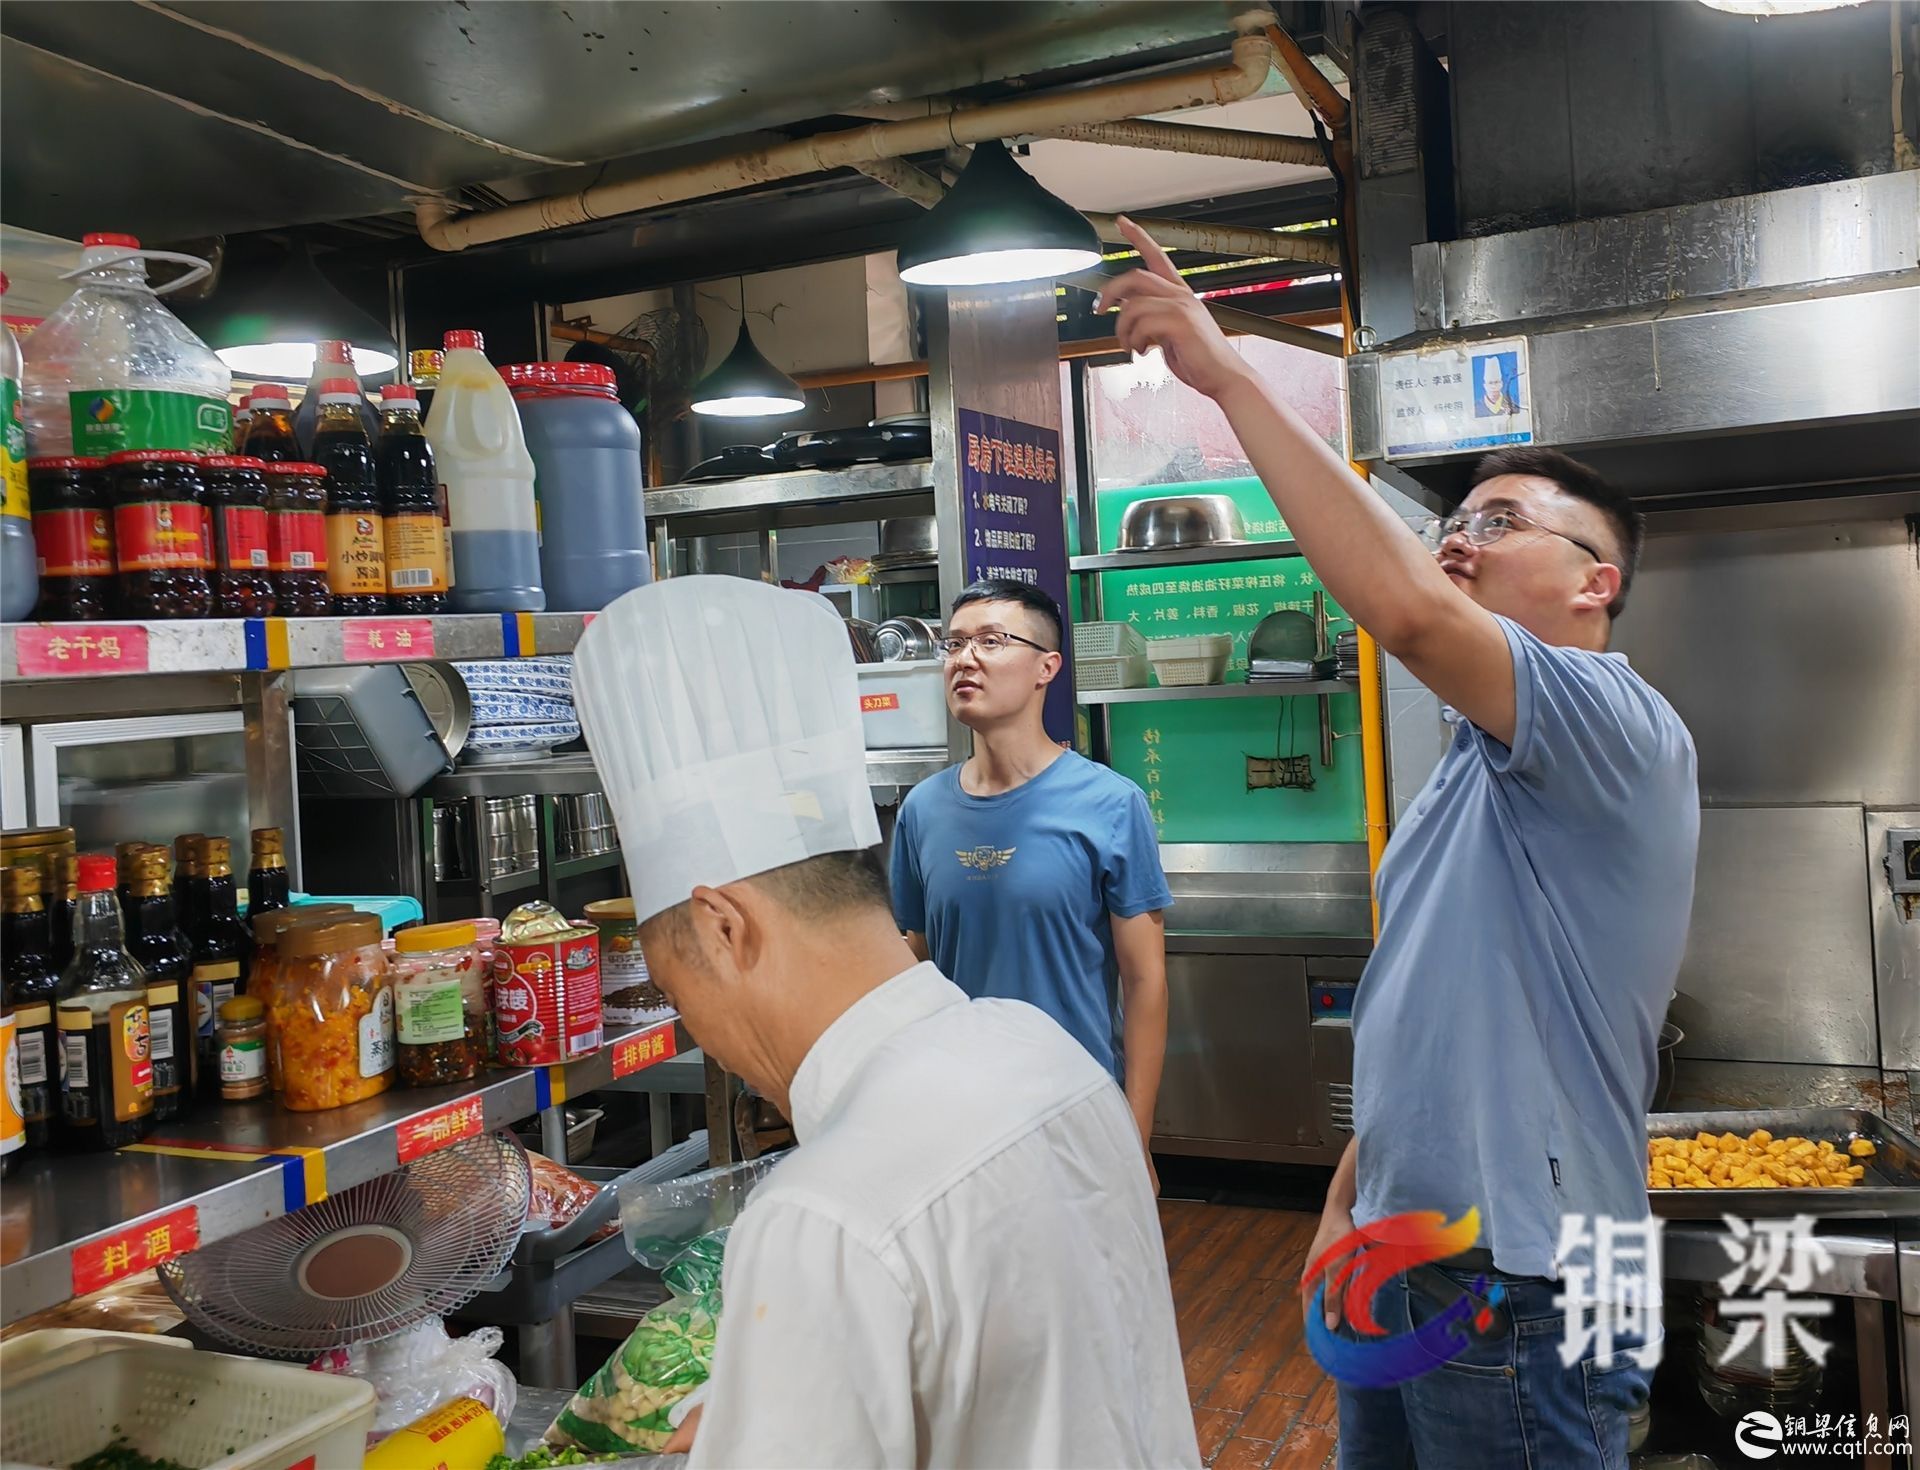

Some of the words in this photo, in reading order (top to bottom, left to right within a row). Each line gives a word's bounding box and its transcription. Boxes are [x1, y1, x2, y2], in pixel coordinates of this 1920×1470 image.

[967, 432, 1057, 484] 厨房下班温馨提示
[48, 636, 121, 660] 老干妈
[623, 1033, 665, 1069] 排骨酱
[412, 1106, 470, 1142] 一品鲜
[103, 1224, 172, 1276] 料酒
